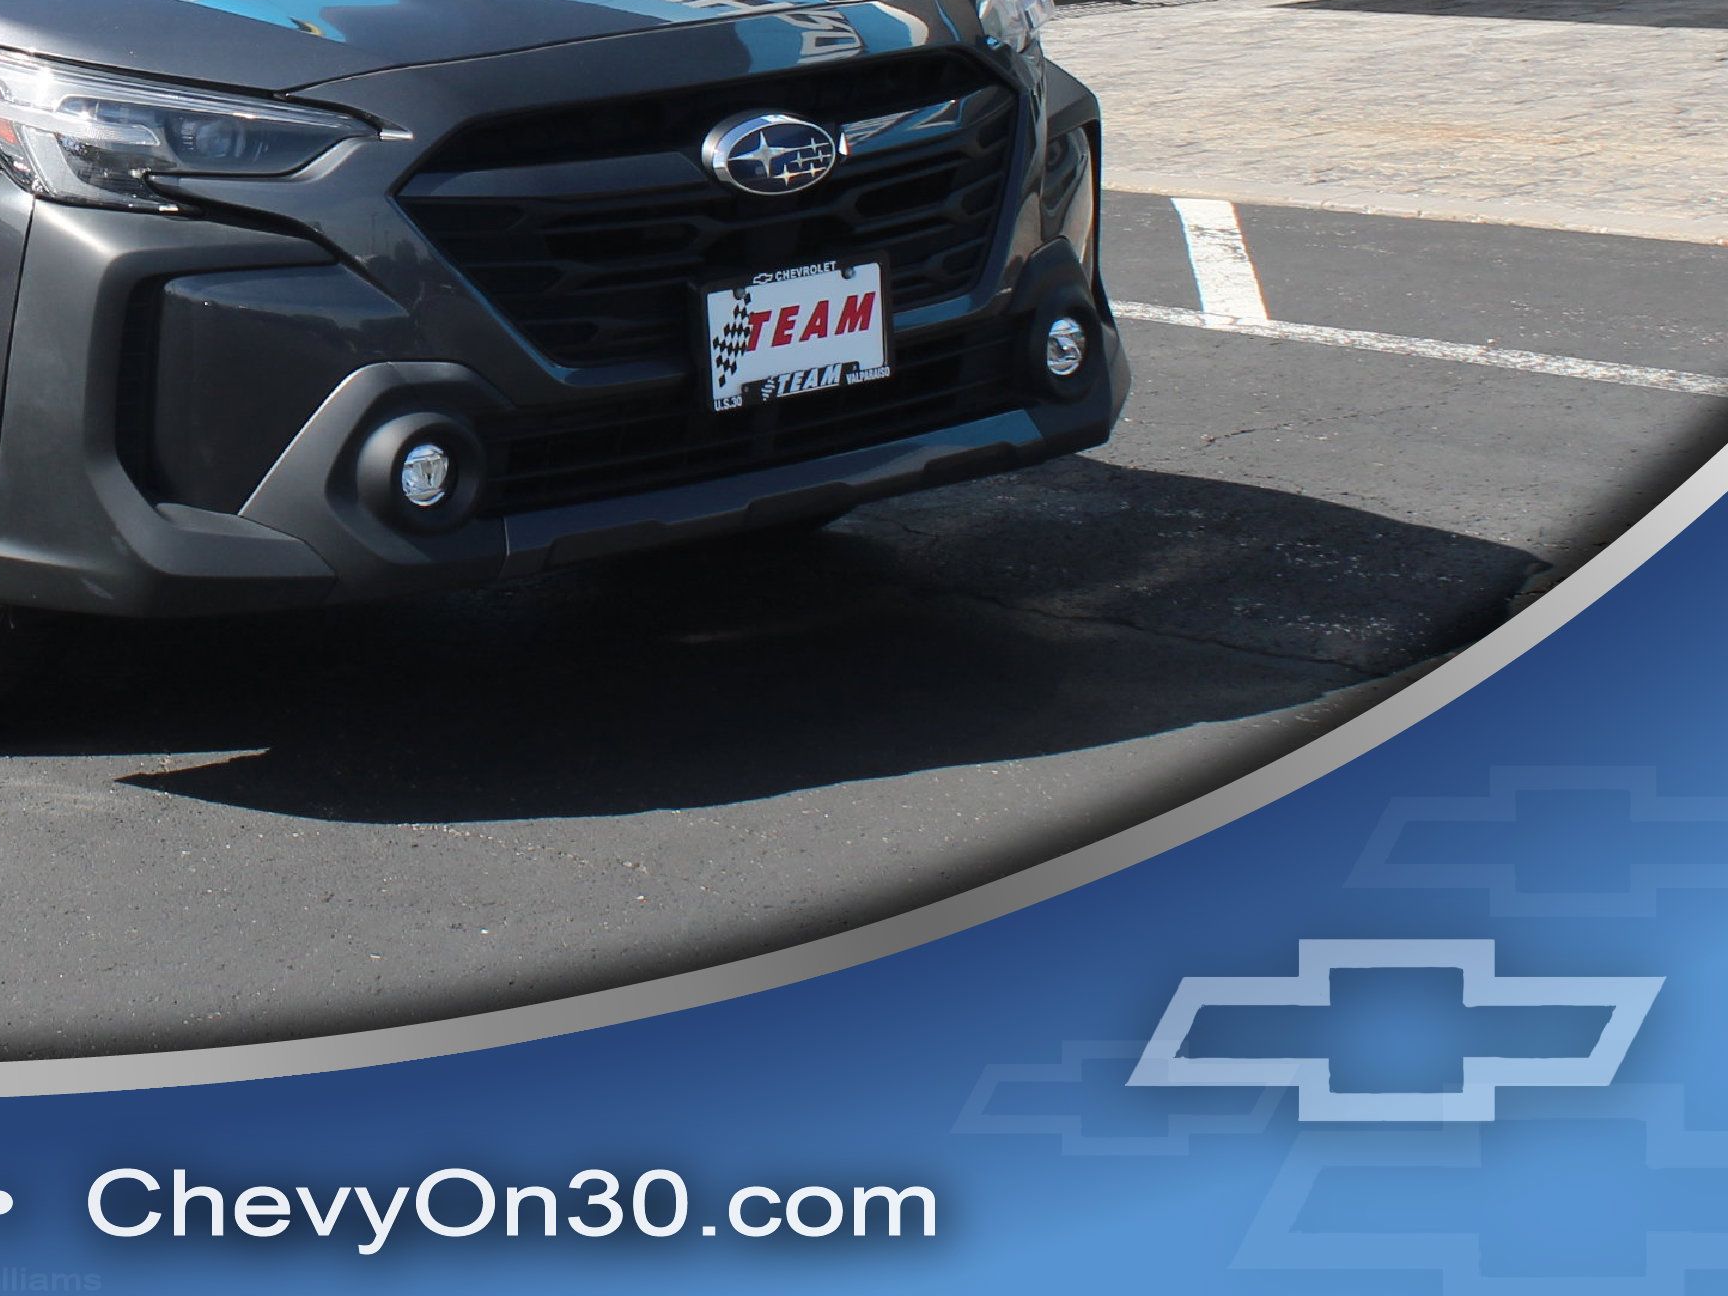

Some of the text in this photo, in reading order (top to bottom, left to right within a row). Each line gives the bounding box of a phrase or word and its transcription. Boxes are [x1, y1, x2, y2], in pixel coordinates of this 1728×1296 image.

[775, 260, 836, 282] CHEVROLET
[746, 291, 876, 352] TEAM
[776, 363, 843, 397] TEAM
